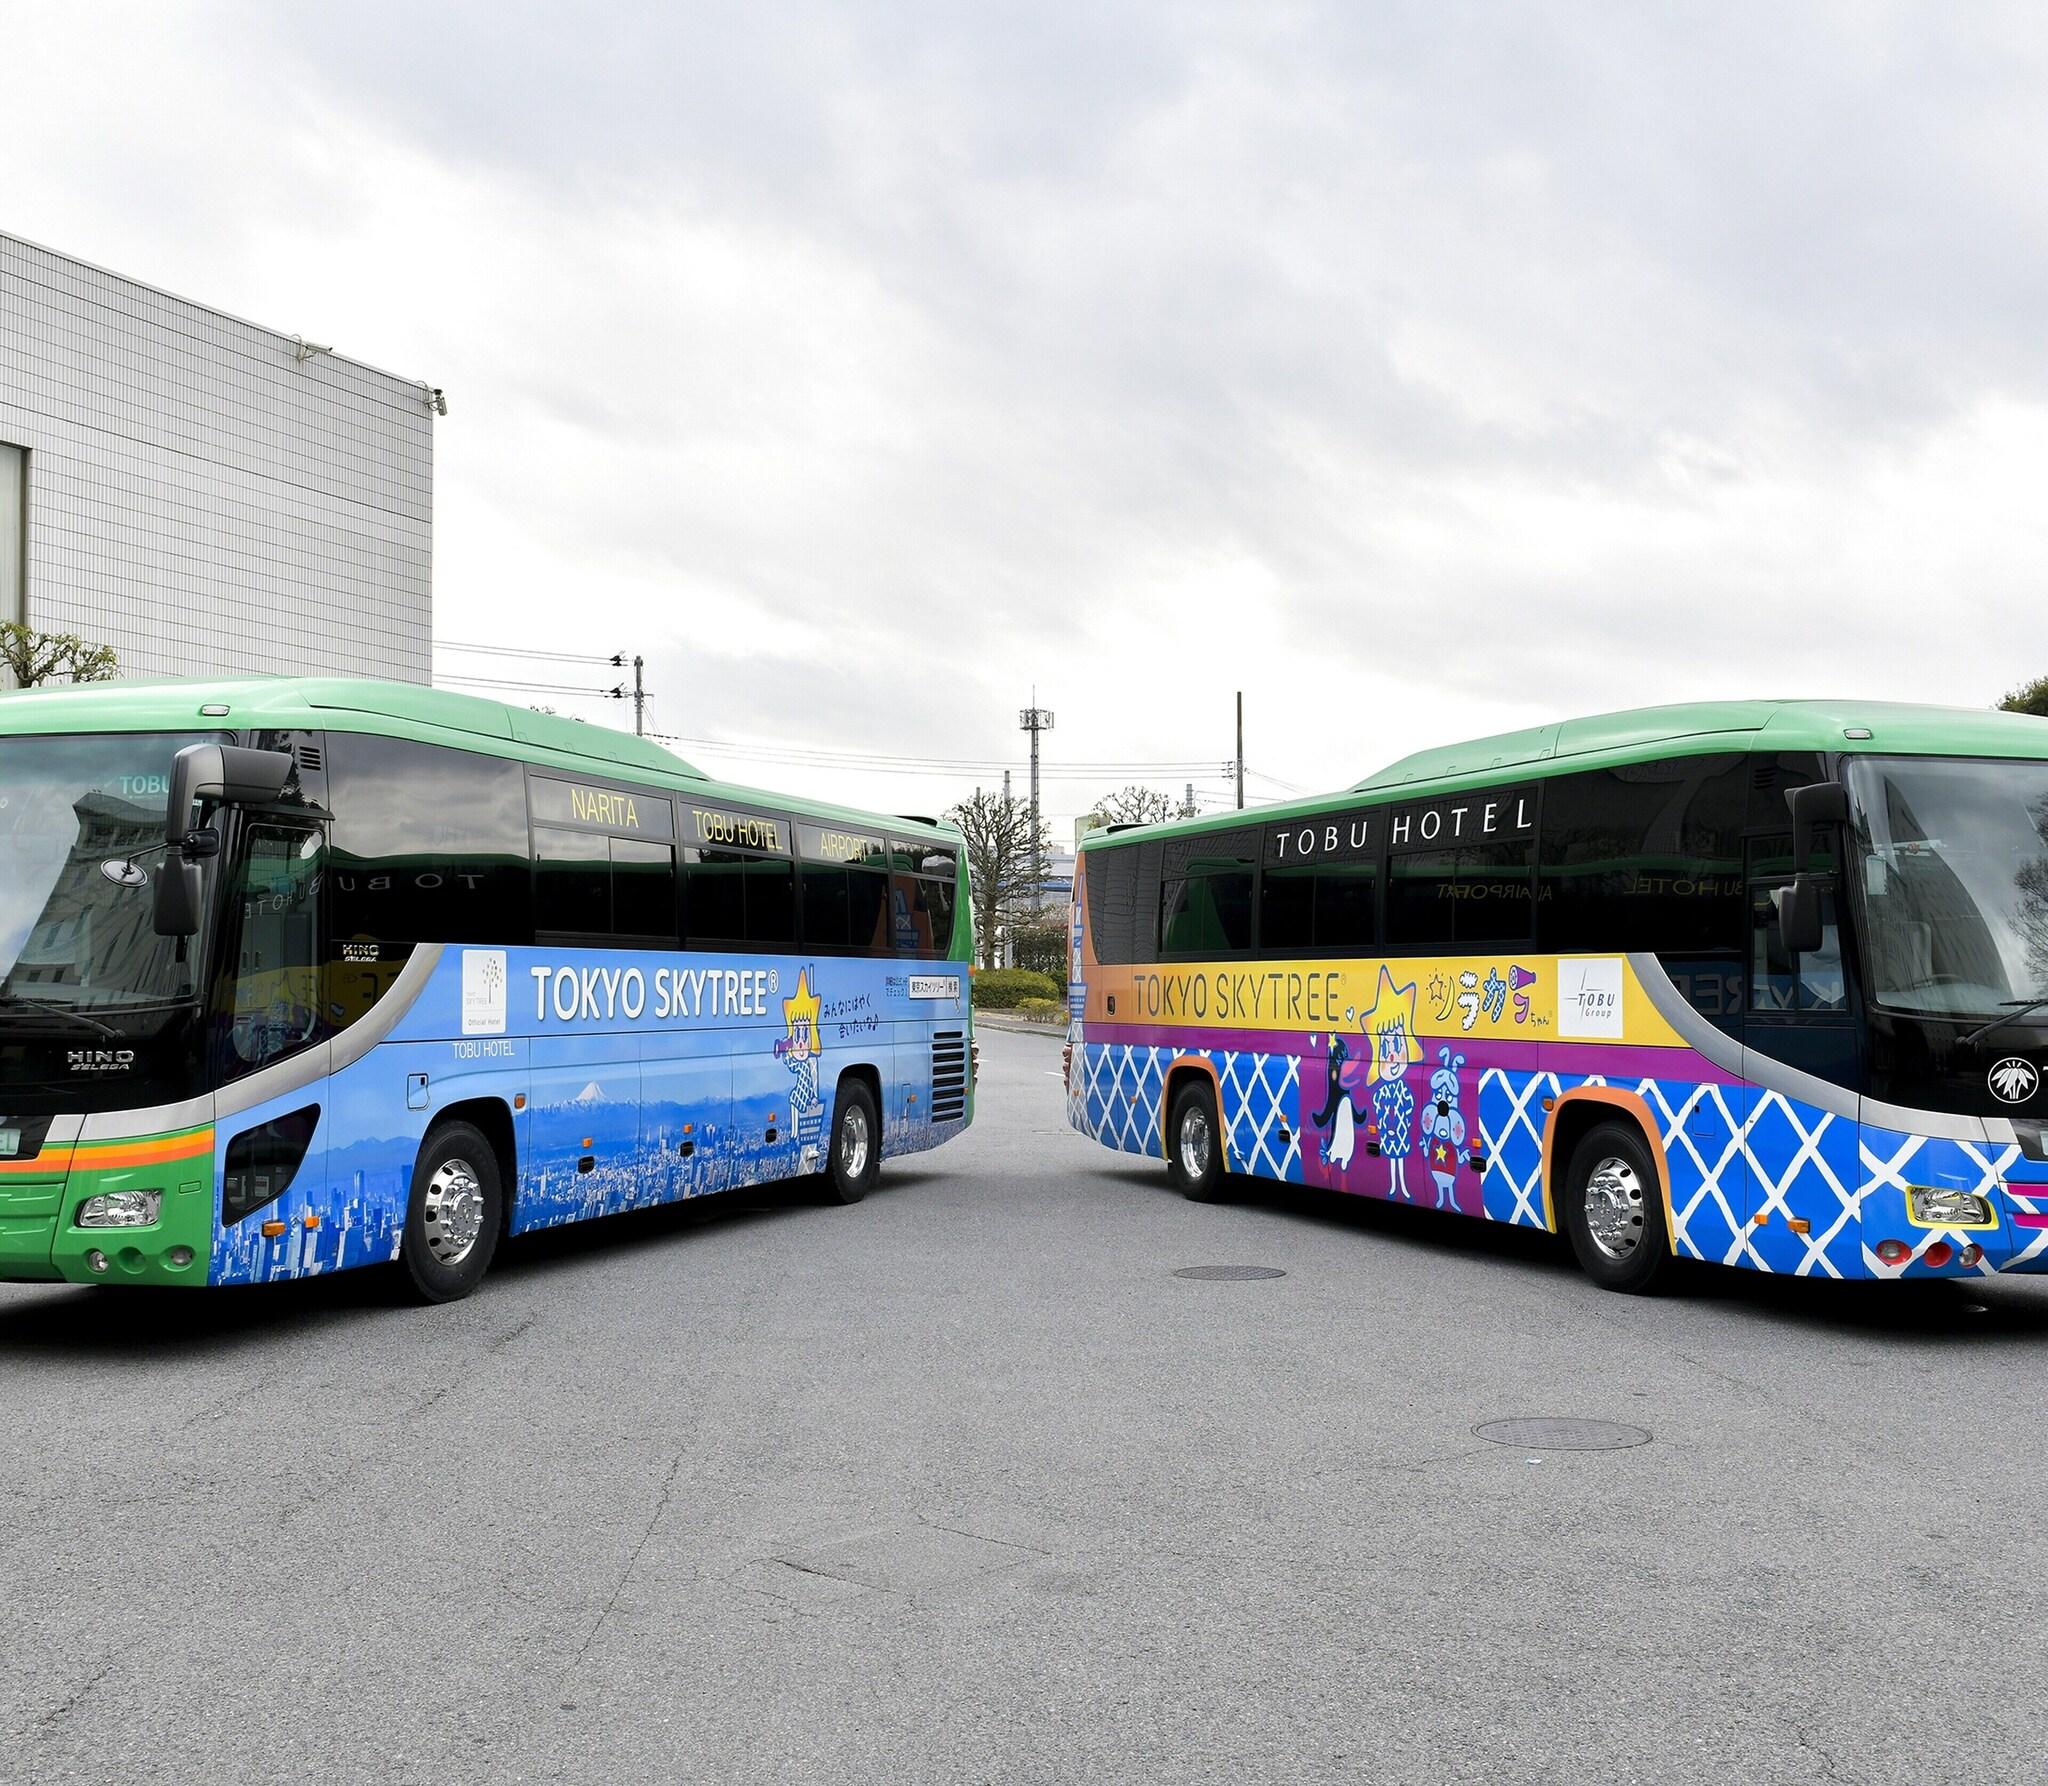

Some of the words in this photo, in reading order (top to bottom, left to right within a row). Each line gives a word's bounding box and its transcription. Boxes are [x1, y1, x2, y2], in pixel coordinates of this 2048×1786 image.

[571, 789, 639, 828] NARITA
[693, 810, 733, 844] TOBU
[738, 821, 783, 850] HOTEL
[1277, 821, 1367, 858] TOBU
[1392, 799, 1532, 844] HOTEL
[820, 832, 867, 862] AIRPORT
[530, 966, 646, 1021] TOKYO
[1134, 973, 1207, 1018] TOKYO
[1577, 993, 1615, 1007] TOBU
[1585, 1008, 1612, 1019] Group
[67, 1050, 135, 1063] HINO
[452, 1042, 481, 1059] TOBU
[483, 1040, 515, 1056] HOTEL
